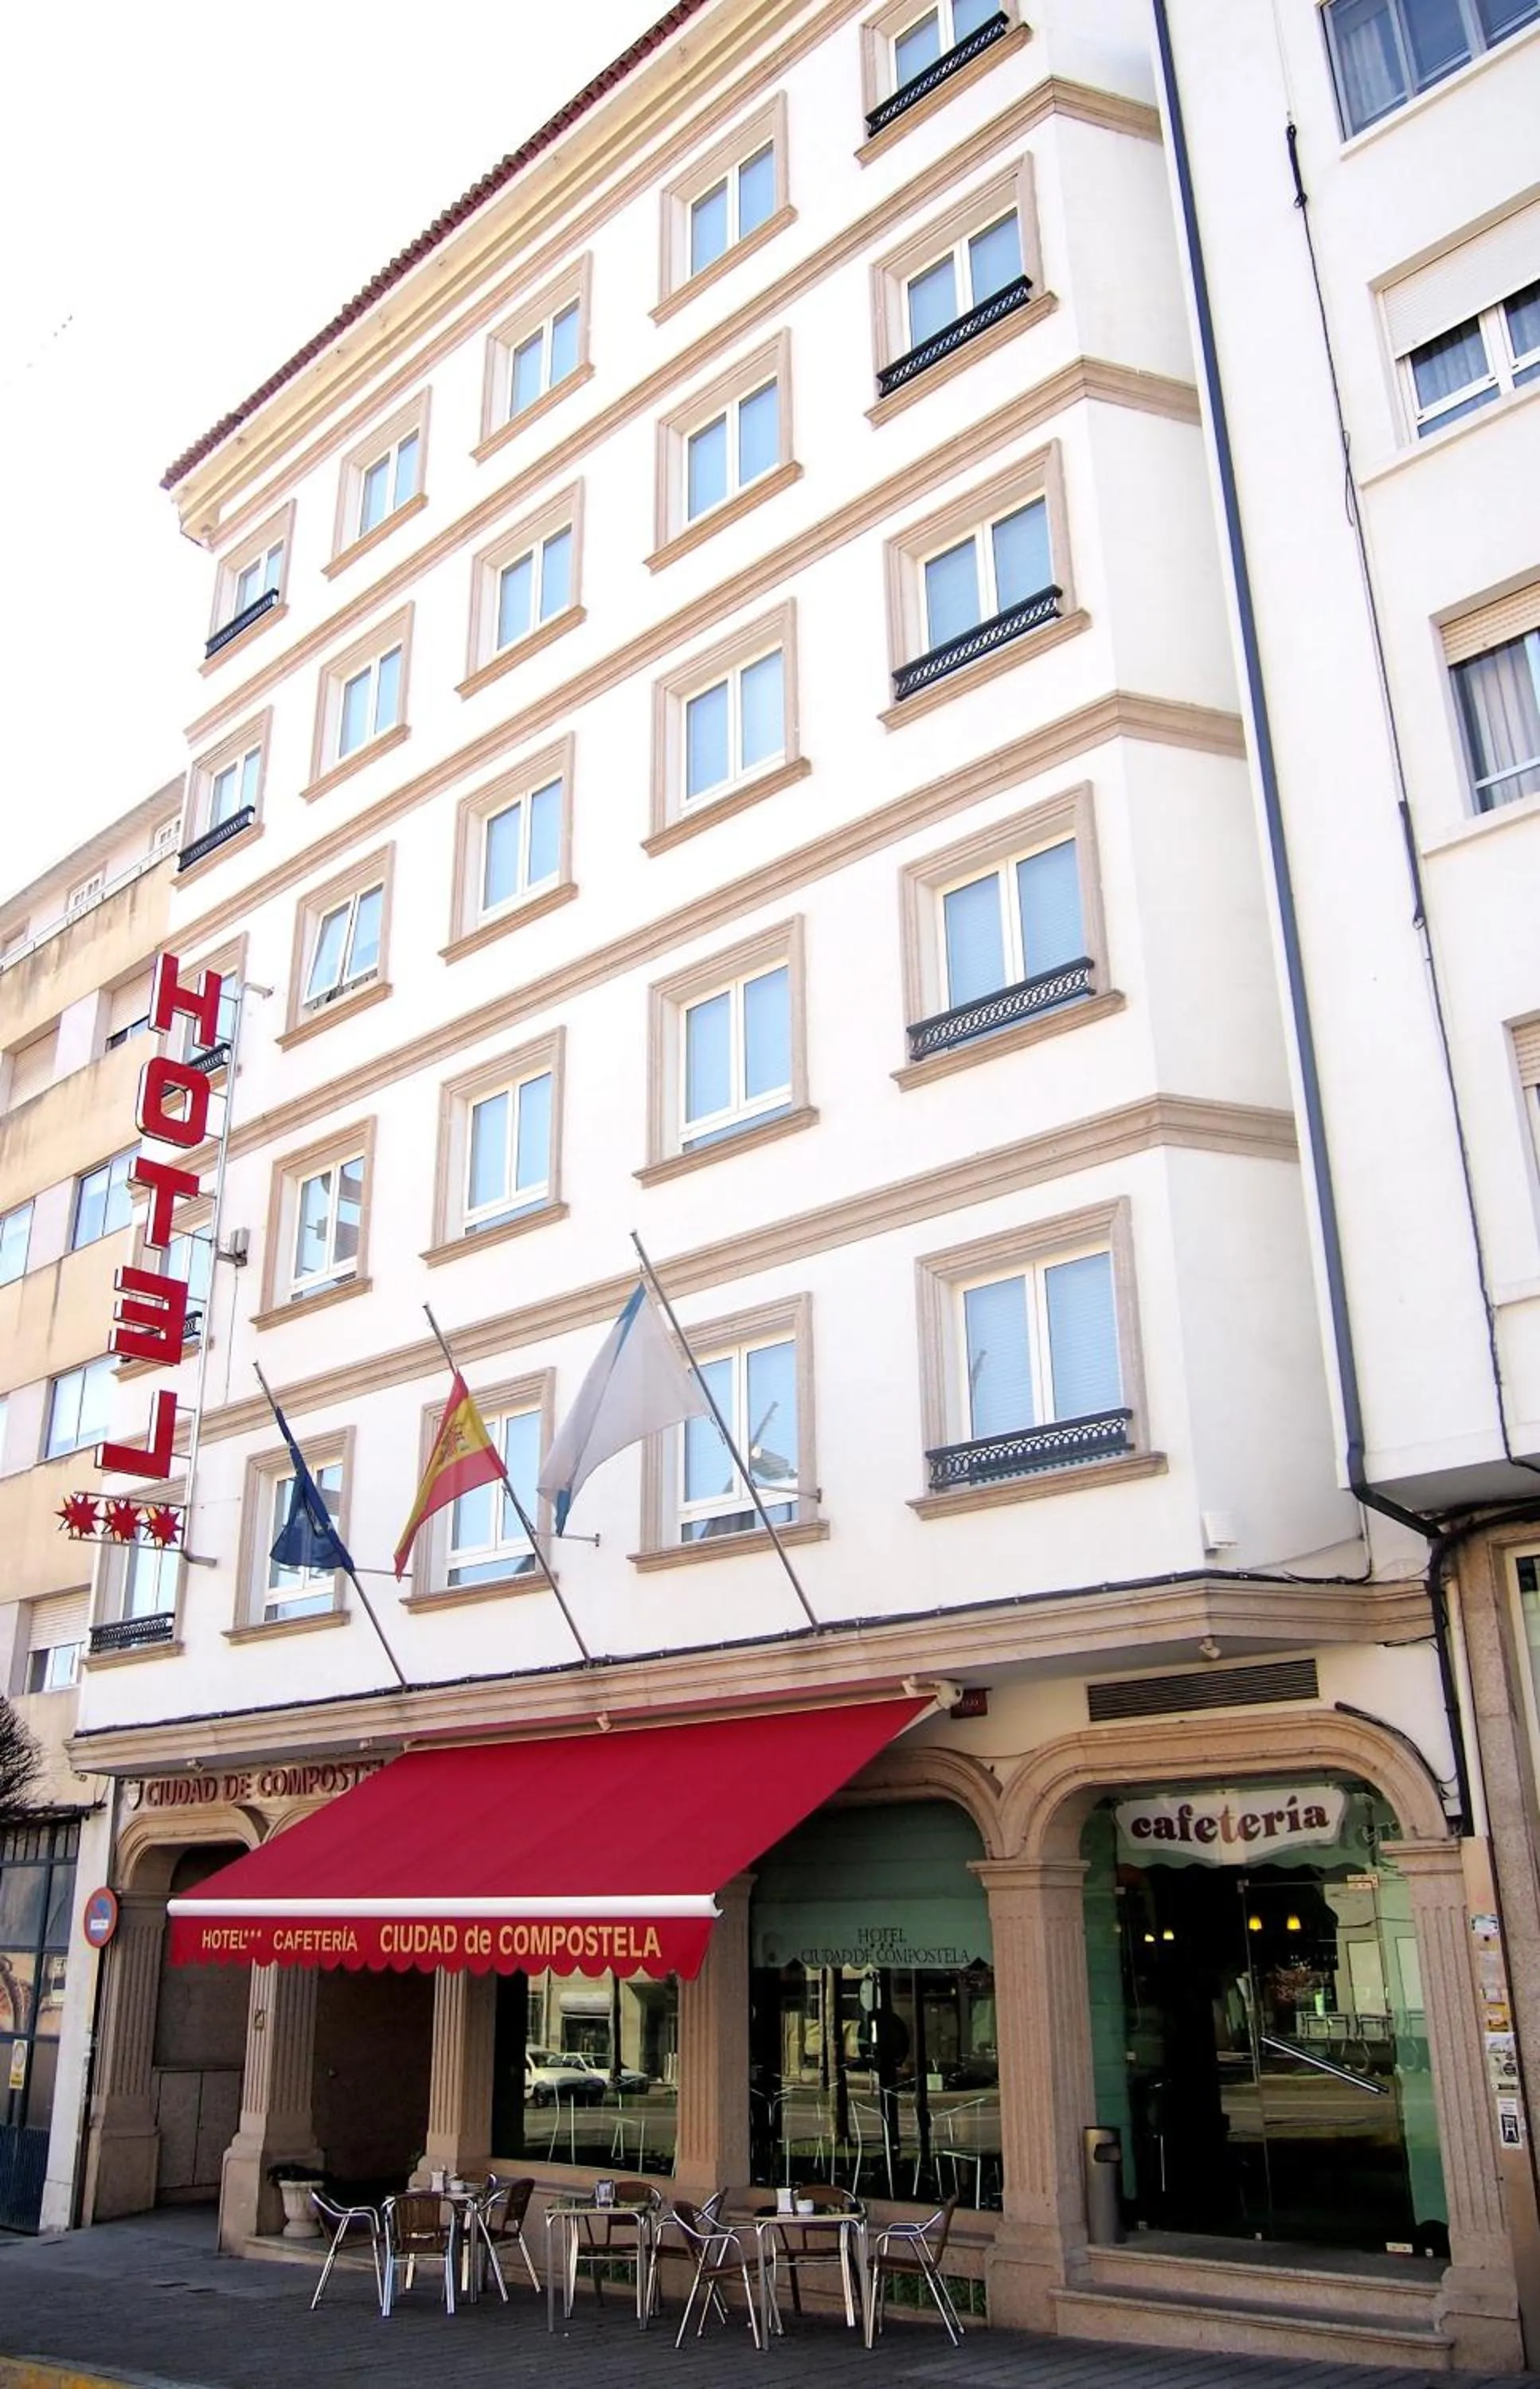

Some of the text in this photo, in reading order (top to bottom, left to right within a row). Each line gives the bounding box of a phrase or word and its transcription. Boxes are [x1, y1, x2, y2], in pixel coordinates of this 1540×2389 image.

[147, 1776, 217, 1807] CIUDAD
[225, 1773, 252, 1801] DE
[1131, 1794, 1331, 1844] cafetería
[273, 1926, 358, 1951] CAFETERÍA
[380, 1924, 458, 1953] CIUDAD
[464, 1926, 491, 1953] de
[498, 1925, 662, 1958] COMPOSTELA
[858, 1927, 907, 1944] HOTEL
[801, 1948, 971, 1964] CIUDAD DE COMPOSTELA
